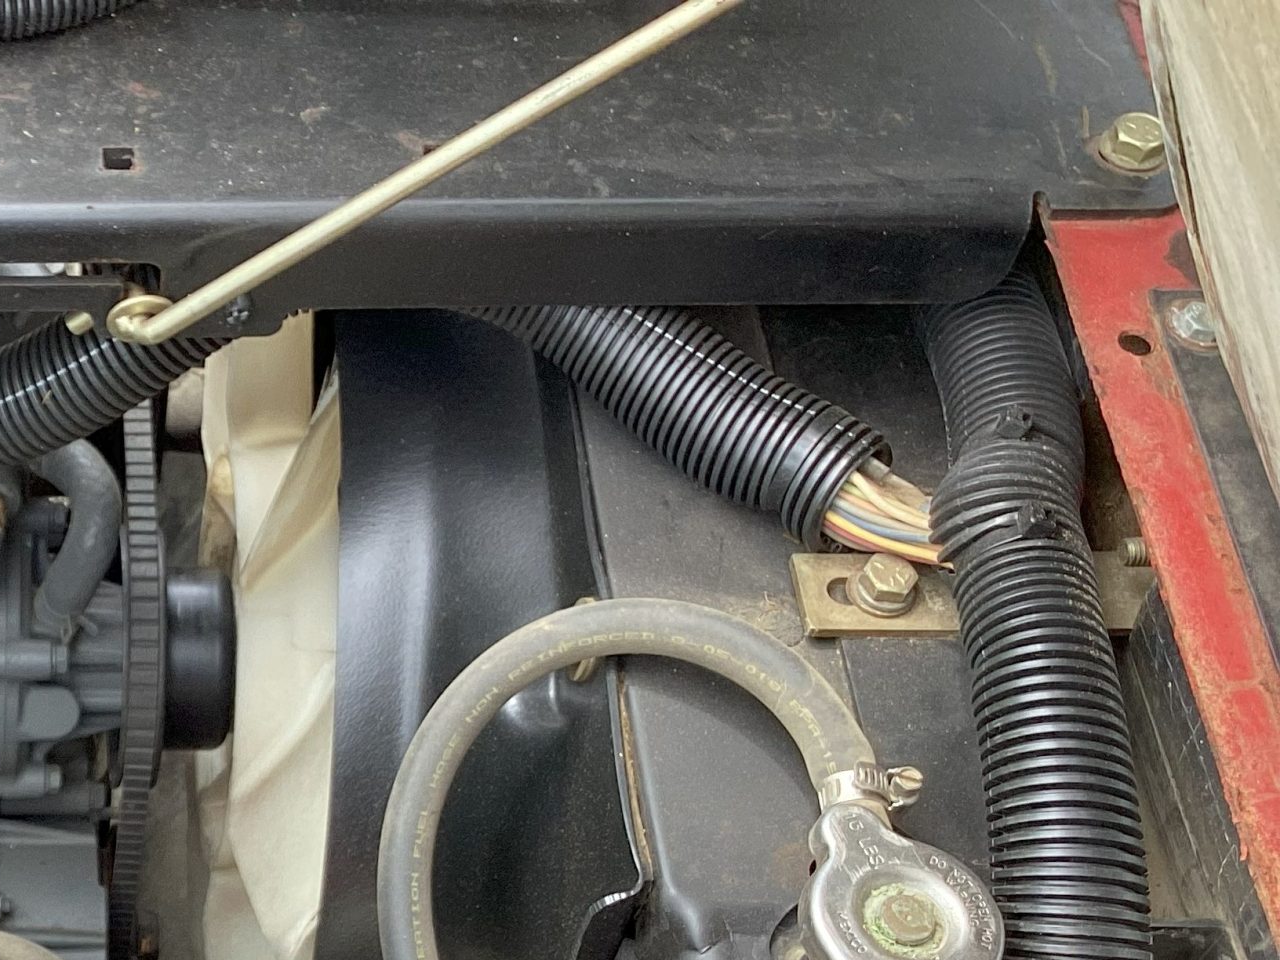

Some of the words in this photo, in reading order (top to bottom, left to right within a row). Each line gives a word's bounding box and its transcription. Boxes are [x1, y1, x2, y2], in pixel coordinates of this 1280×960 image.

[413, 810, 429, 858] FUEL
[429, 734, 458, 788] HOSE
[465, 686, 500, 723] NON
[508, 631, 655, 681] REINFORCED
[929, 855, 946, 869] DO
[951, 868, 974, 887] NOT
[971, 894, 991, 921] OPEN
[981, 927, 993, 950] HOT
